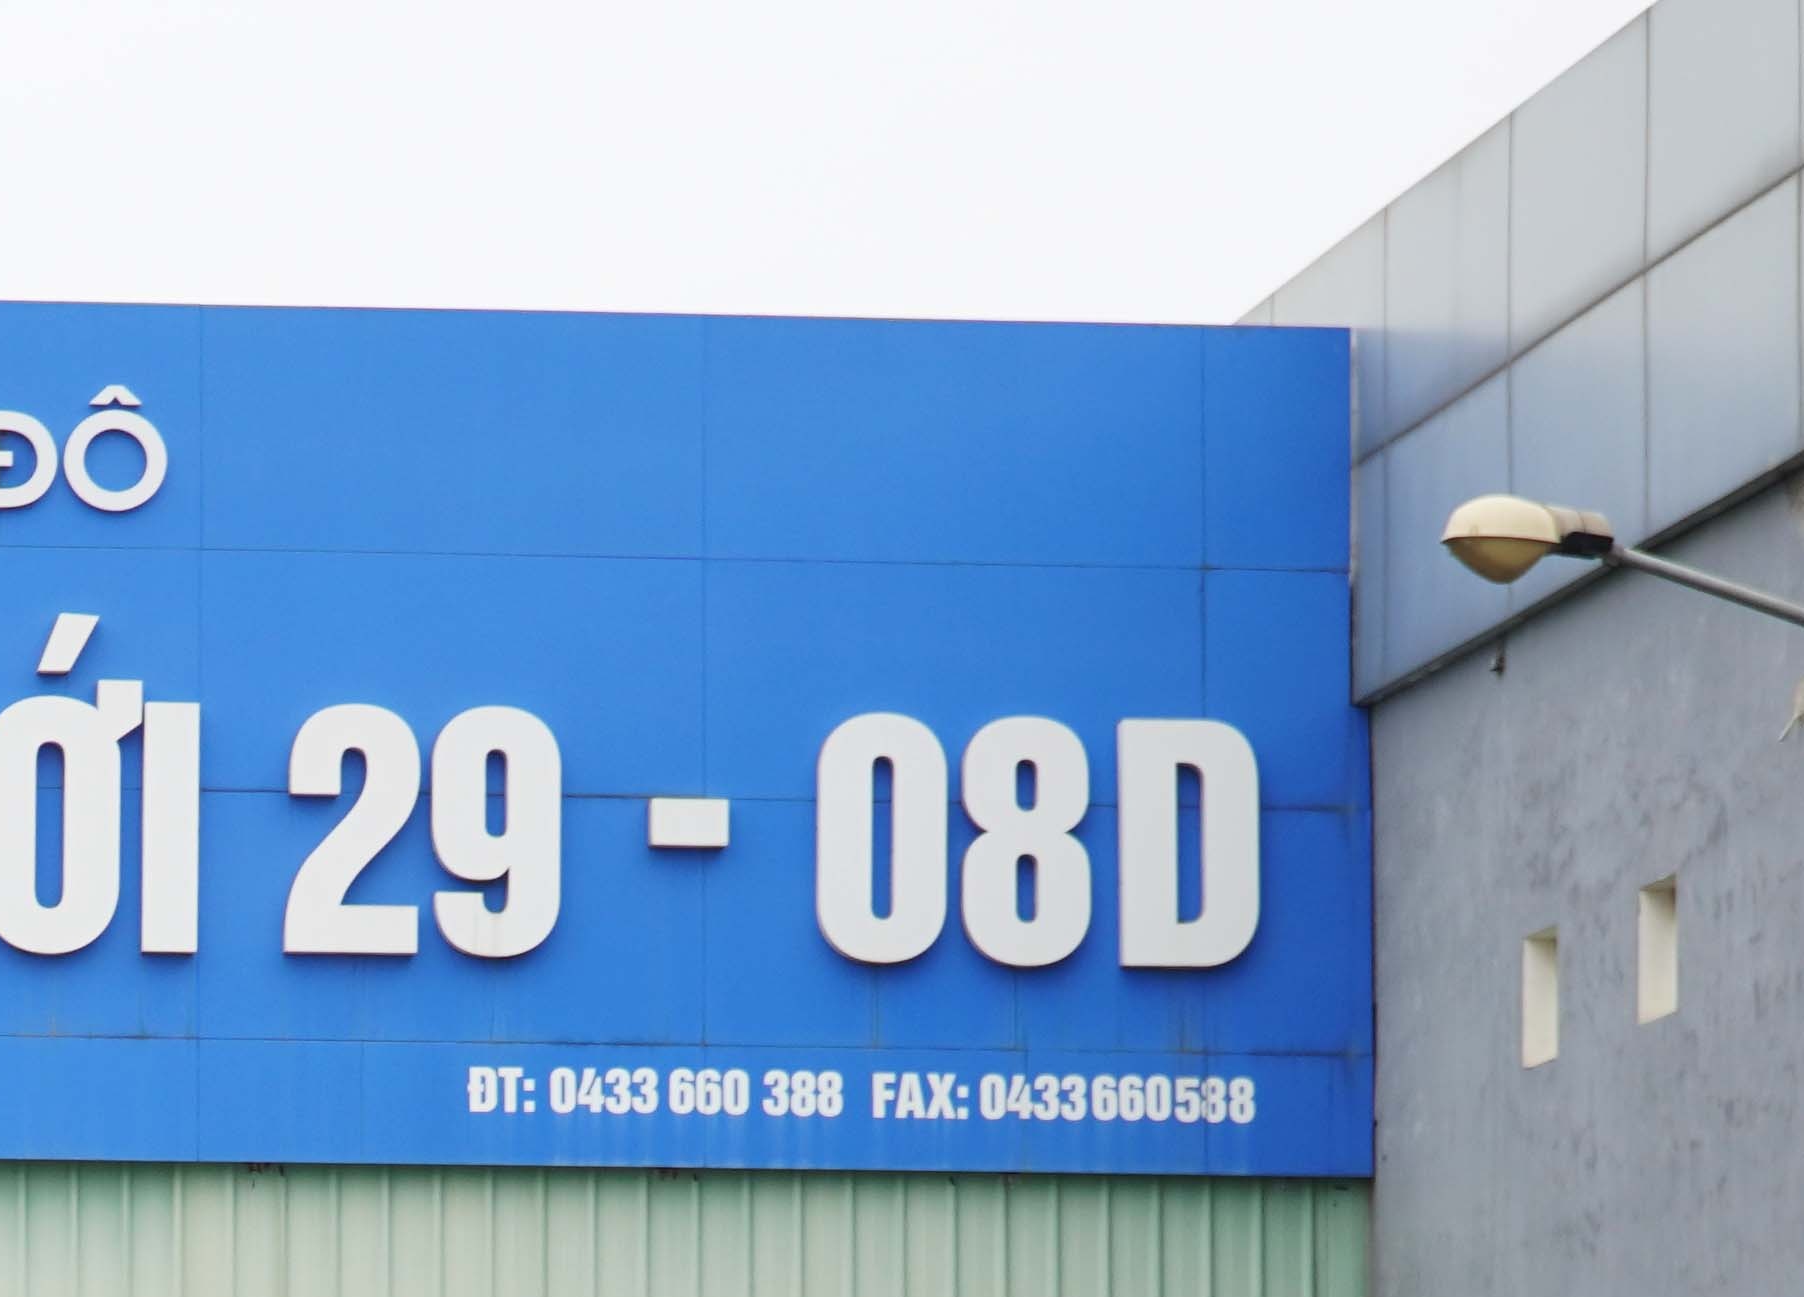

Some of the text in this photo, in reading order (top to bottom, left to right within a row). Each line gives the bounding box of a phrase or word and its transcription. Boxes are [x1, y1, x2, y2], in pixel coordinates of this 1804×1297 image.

[284, 703, 562, 958] 29
[817, 713, 1259, 968] 08D
[467, 1067, 535, 1113] ĐT:
[549, 1067, 658, 1115] 0433
[668, 1069, 750, 1116] 660
[762, 1071, 843, 1118] 388
[872, 1073, 969, 1120] FAX:
